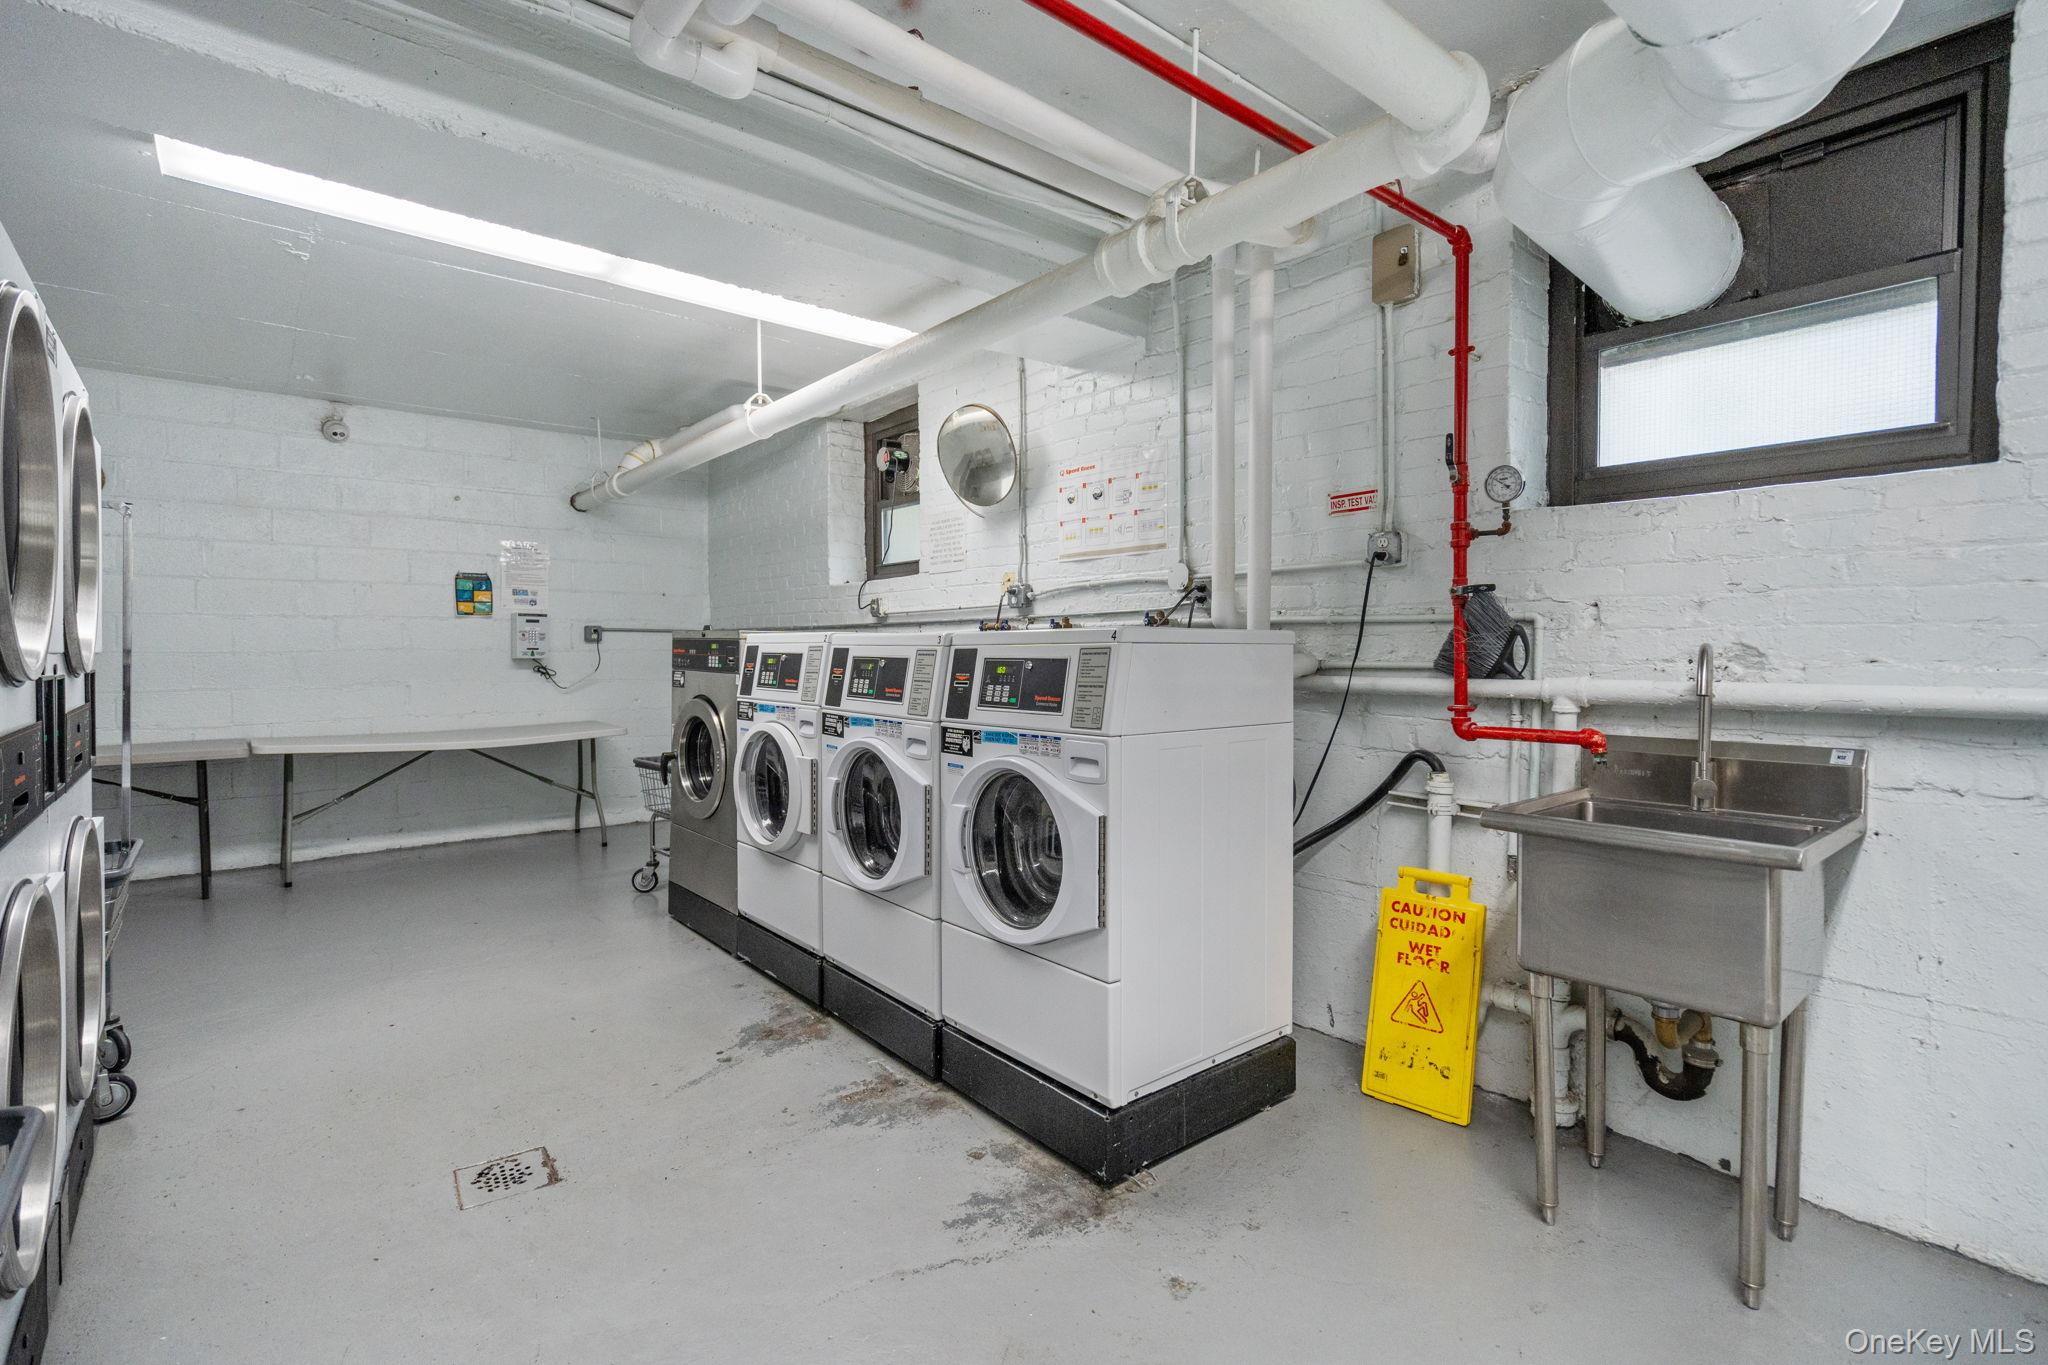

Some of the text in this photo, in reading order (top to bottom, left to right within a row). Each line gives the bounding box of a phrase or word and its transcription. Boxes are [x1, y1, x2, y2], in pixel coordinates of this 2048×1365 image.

[1330, 499, 1347, 510] INSP.
[1348, 496, 1363, 508] TEST
[823, 634, 828, 643] 2
[937, 635, 942, 644] 3
[1110, 629, 1118, 641] 4
[1391, 900, 1467, 925] CAUION
[1389, 916, 1455, 939] CUIDAD
[1408, 940, 1442, 957] WET
